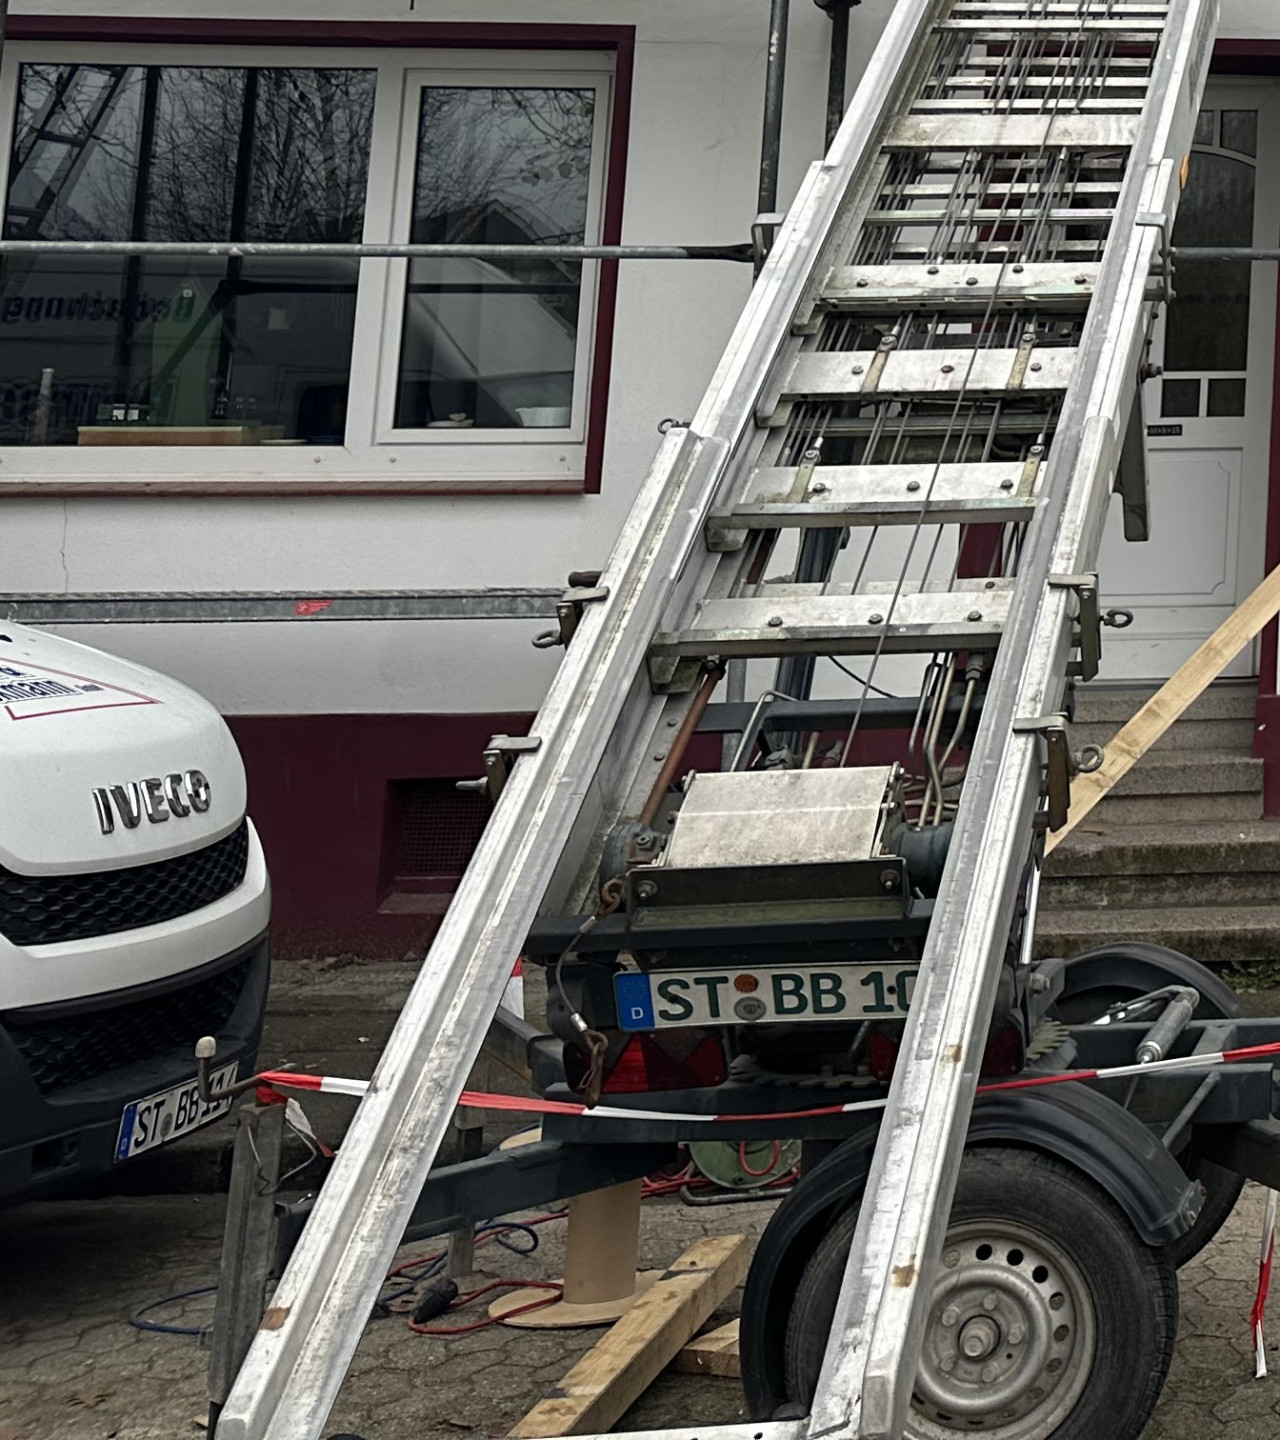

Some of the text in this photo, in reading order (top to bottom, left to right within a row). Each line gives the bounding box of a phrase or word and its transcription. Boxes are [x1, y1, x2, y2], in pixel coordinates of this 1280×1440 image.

[92, 769, 212, 835] IVECO
[657, 976, 729, 1021] ST
[771, 972, 846, 1015] BB
[133, 1099, 166, 1149] ST
[174, 1086, 200, 1132] BB
